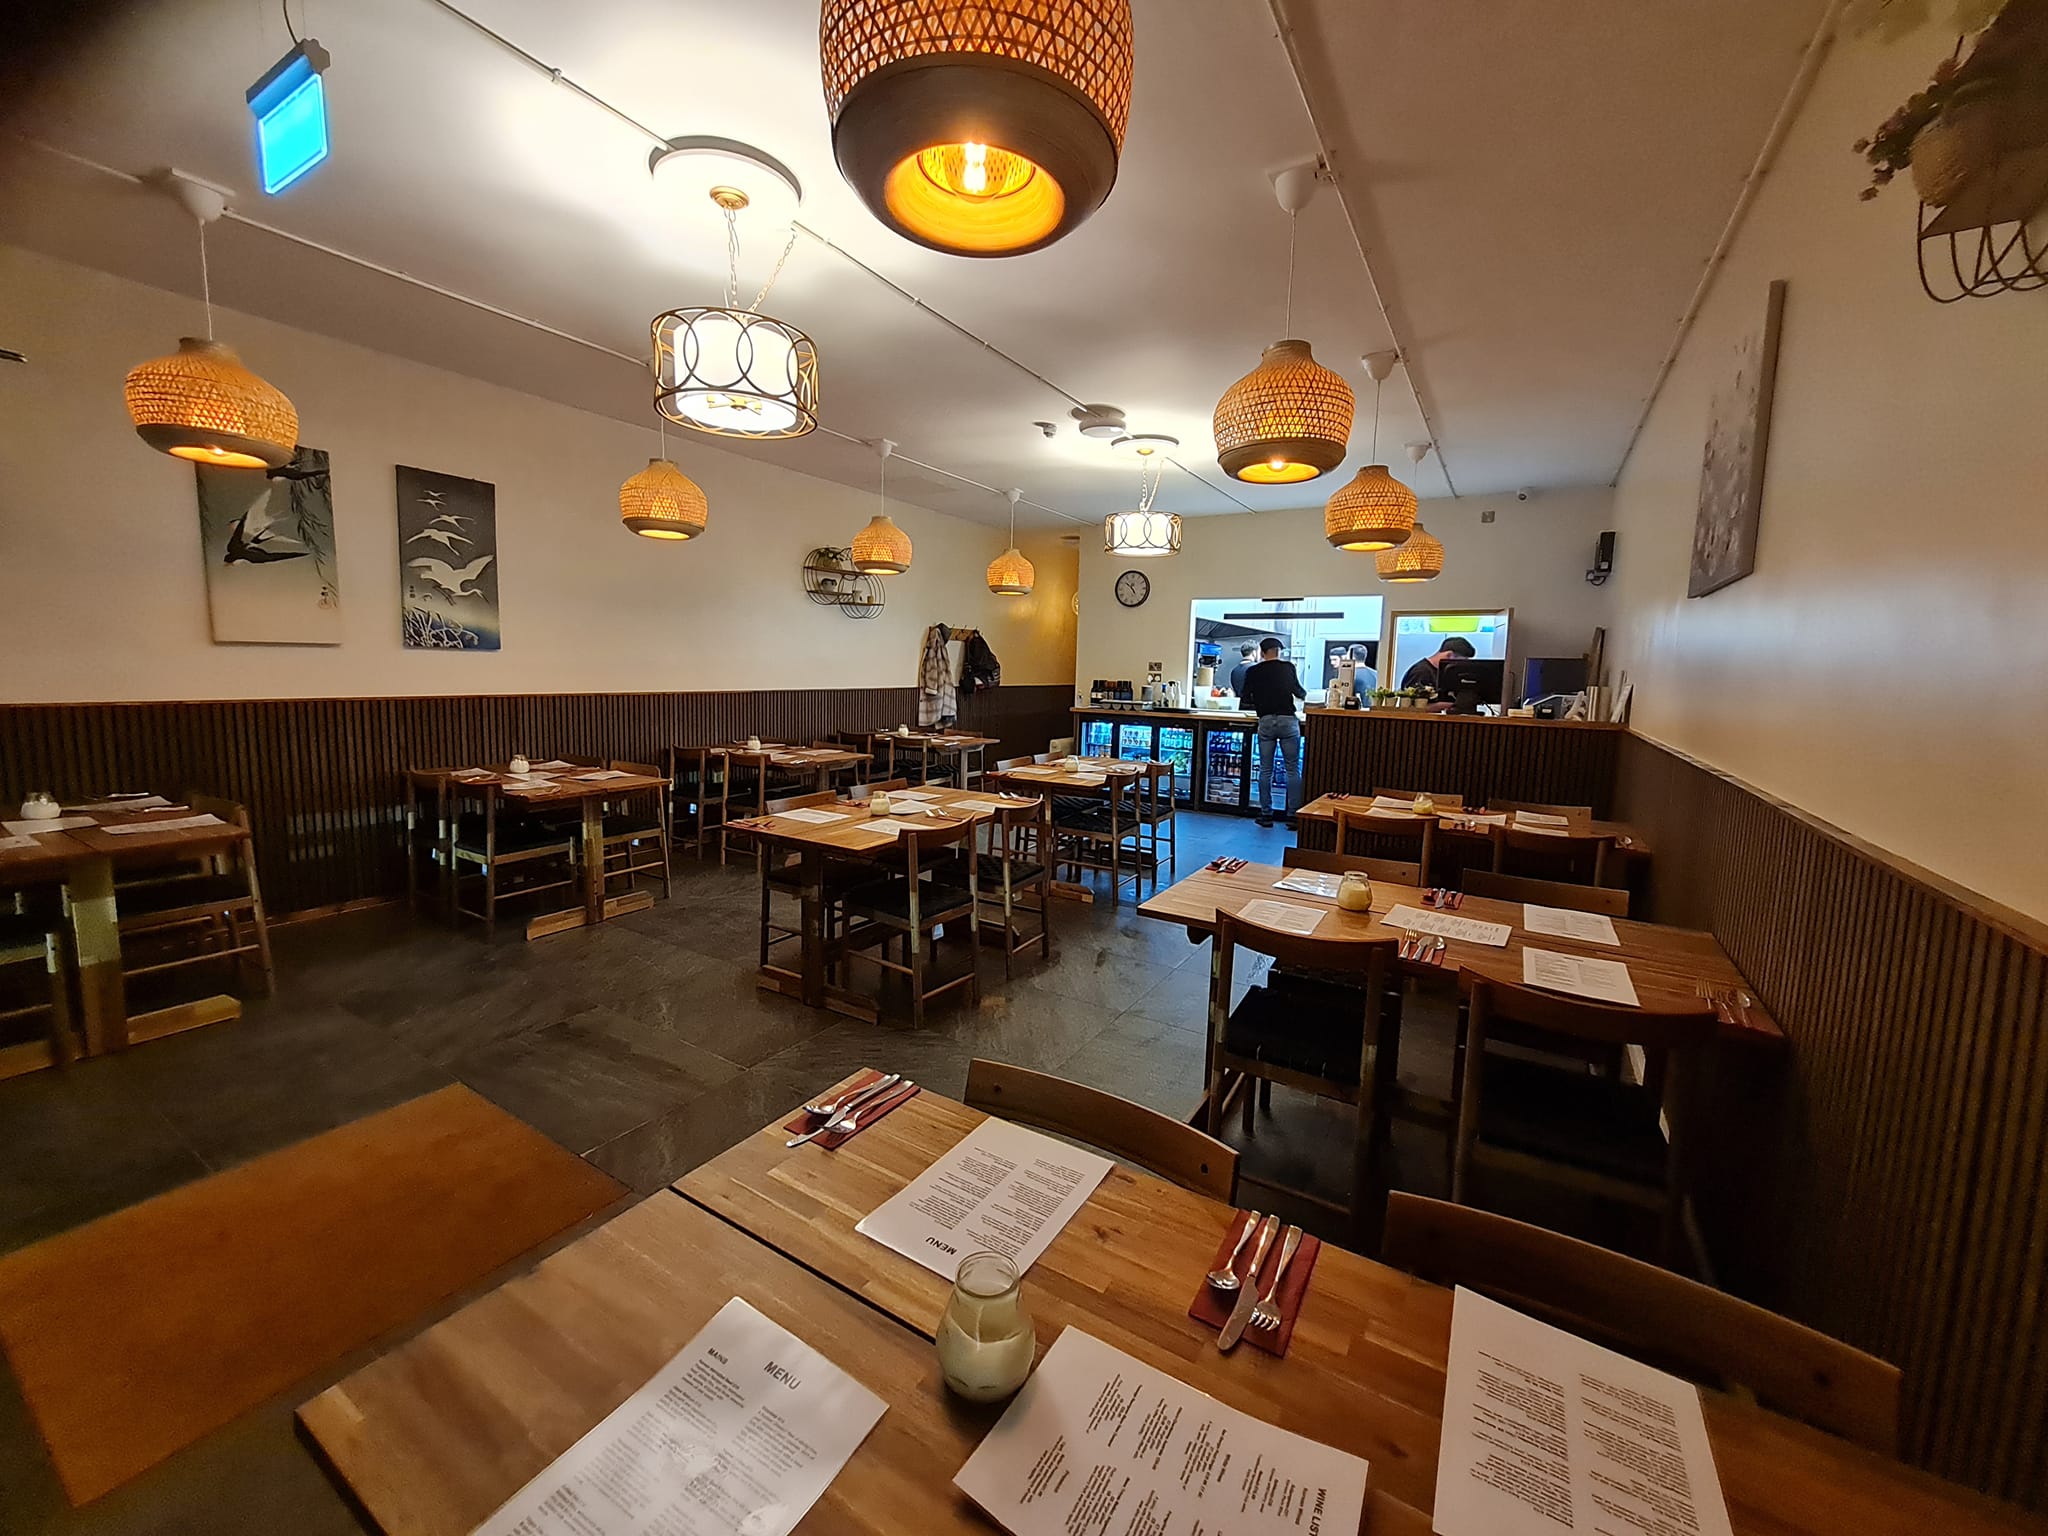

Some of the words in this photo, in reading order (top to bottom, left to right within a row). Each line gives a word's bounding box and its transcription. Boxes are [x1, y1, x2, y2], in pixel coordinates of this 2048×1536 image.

[925, 1236, 958, 1255] MENU
[763, 1361, 802, 1390] MENU
[1313, 1487, 1328, 1515] WINE
